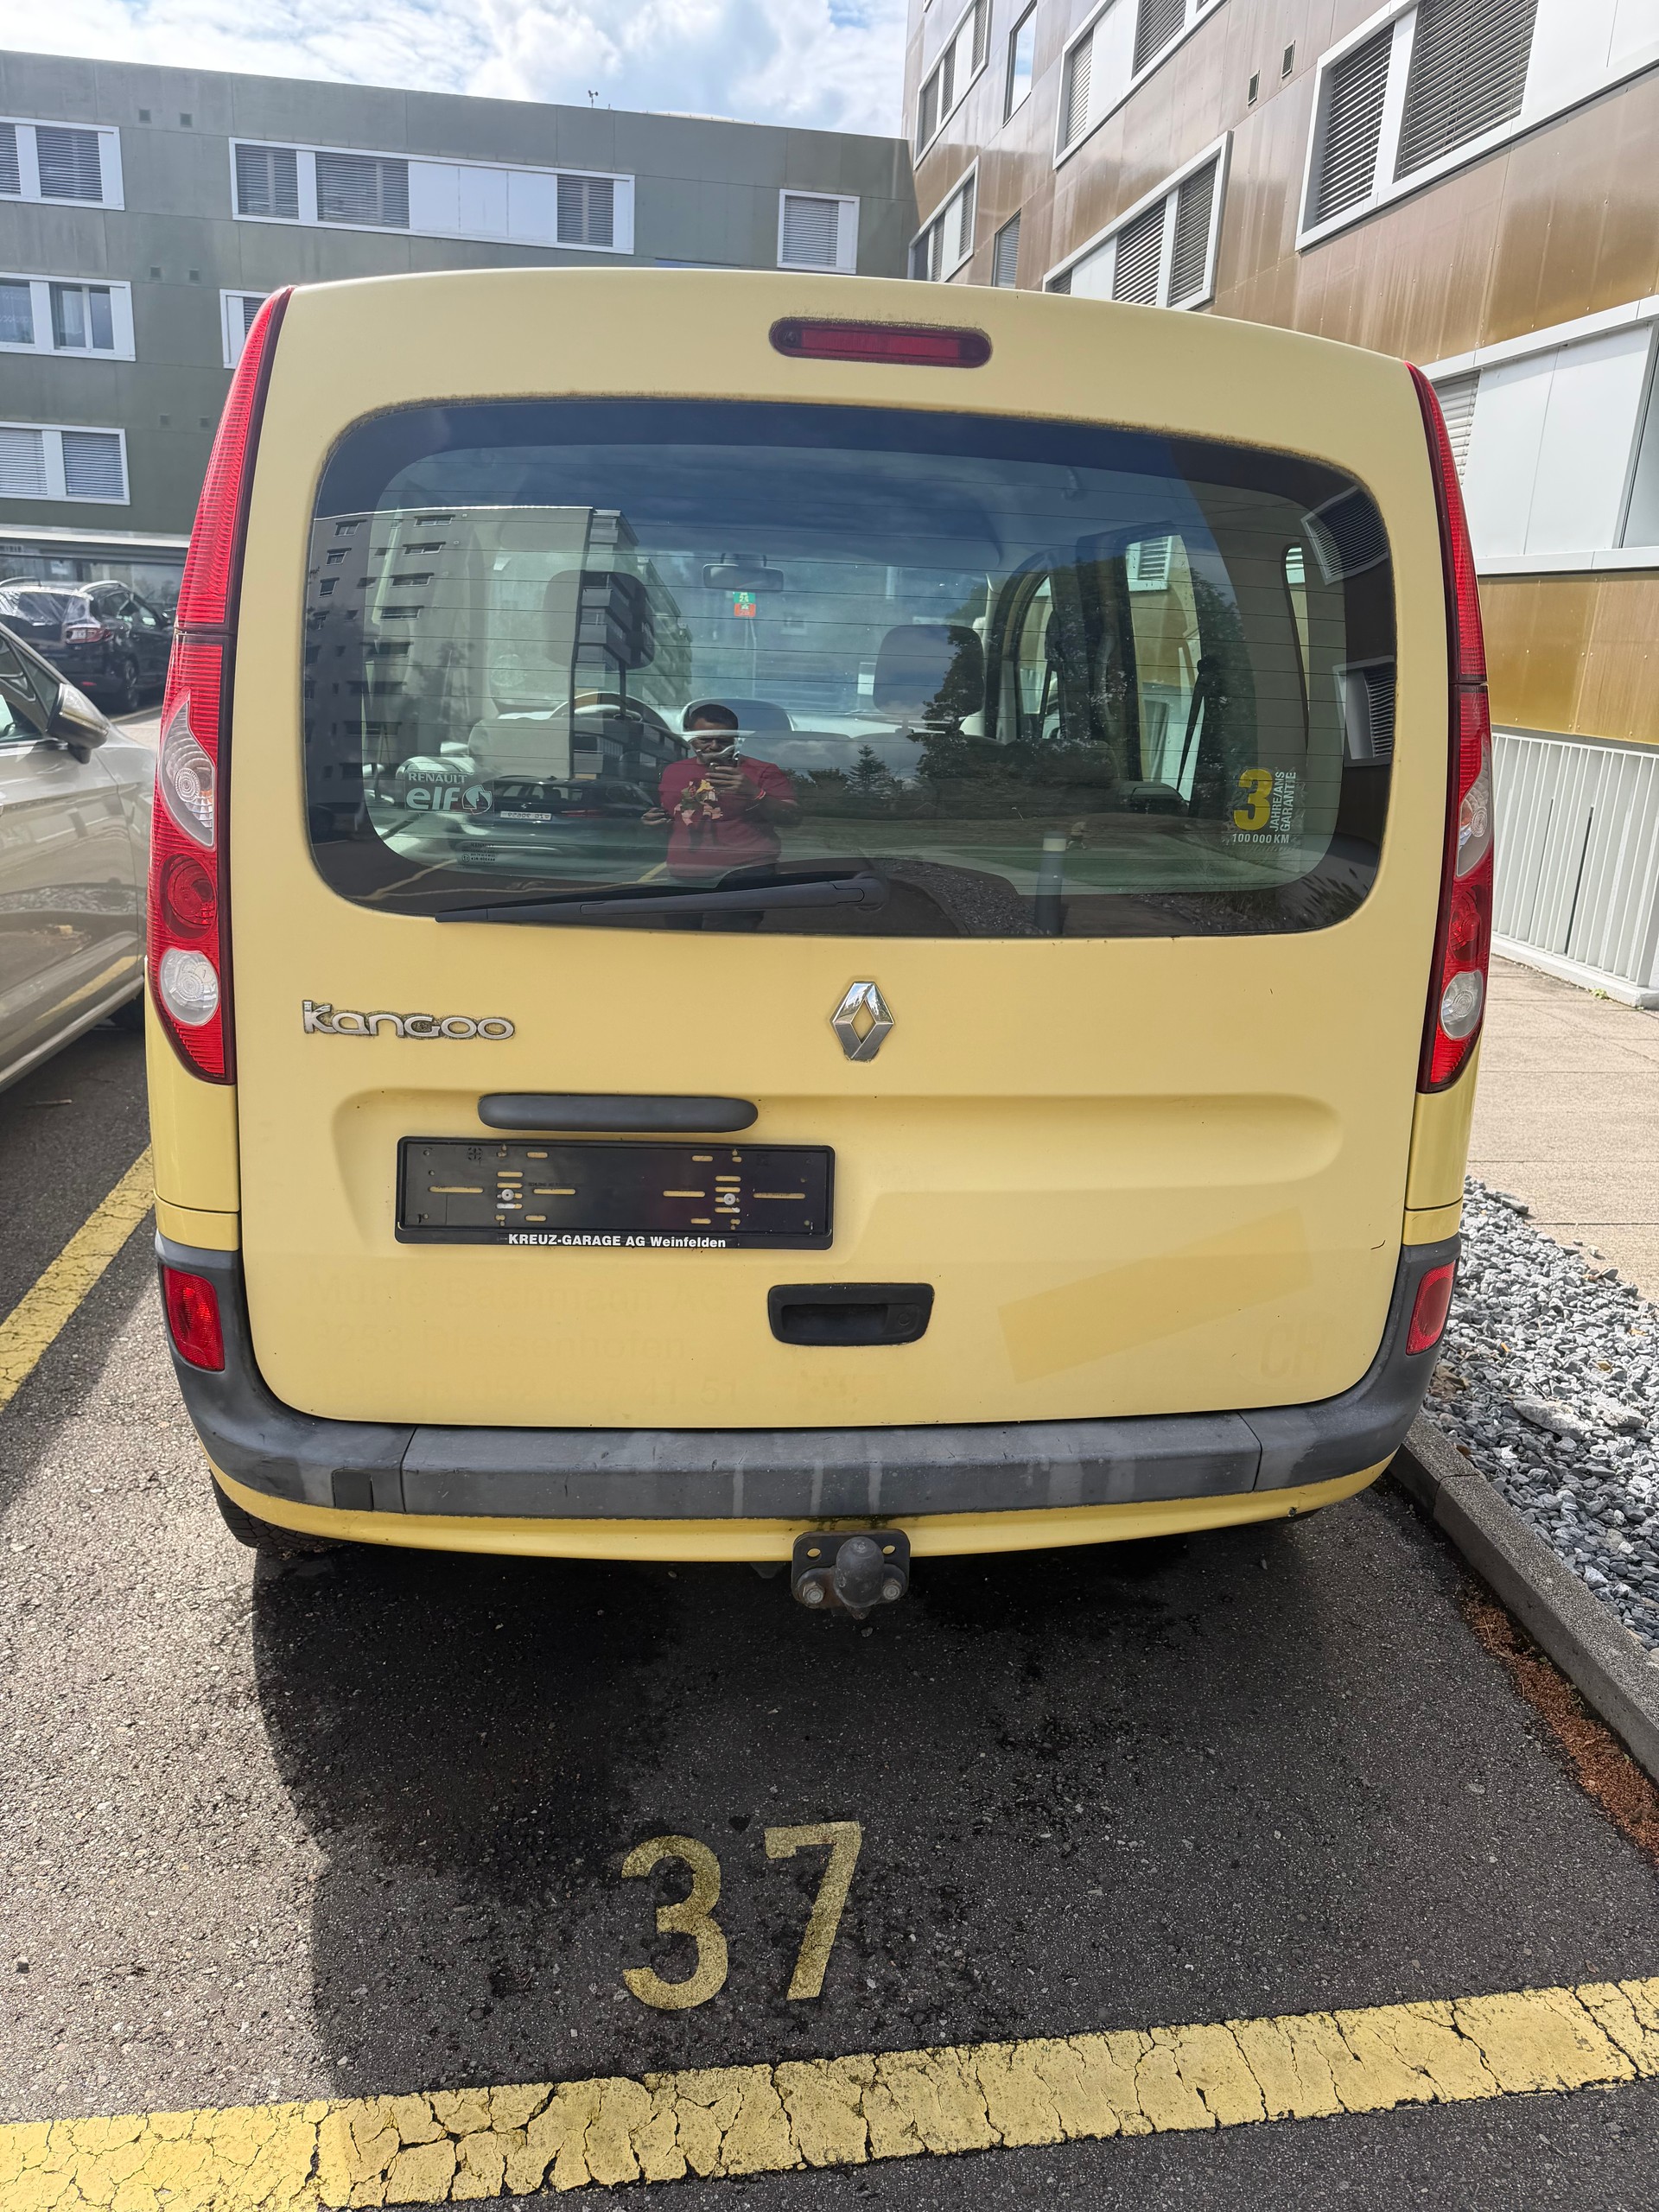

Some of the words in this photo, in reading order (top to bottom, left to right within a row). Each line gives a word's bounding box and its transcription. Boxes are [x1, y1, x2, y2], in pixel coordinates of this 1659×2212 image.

[408, 772, 467, 784] RENAULT
[406, 786, 460, 810] elf
[1233, 768, 1274, 831] 3
[1269, 771, 1285, 832] JAHRE/ANS
[1280, 772, 1296, 832] GARANTIE
[1232, 833, 1250, 842] 100
[1252, 834, 1272, 843] 000
[1274, 834, 1290, 843] KM
[508, 1233, 621, 1246] KREUZ-GARAGE
[625, 1236, 645, 1247] AG
[650, 1236, 726, 1248] Weinfelden
